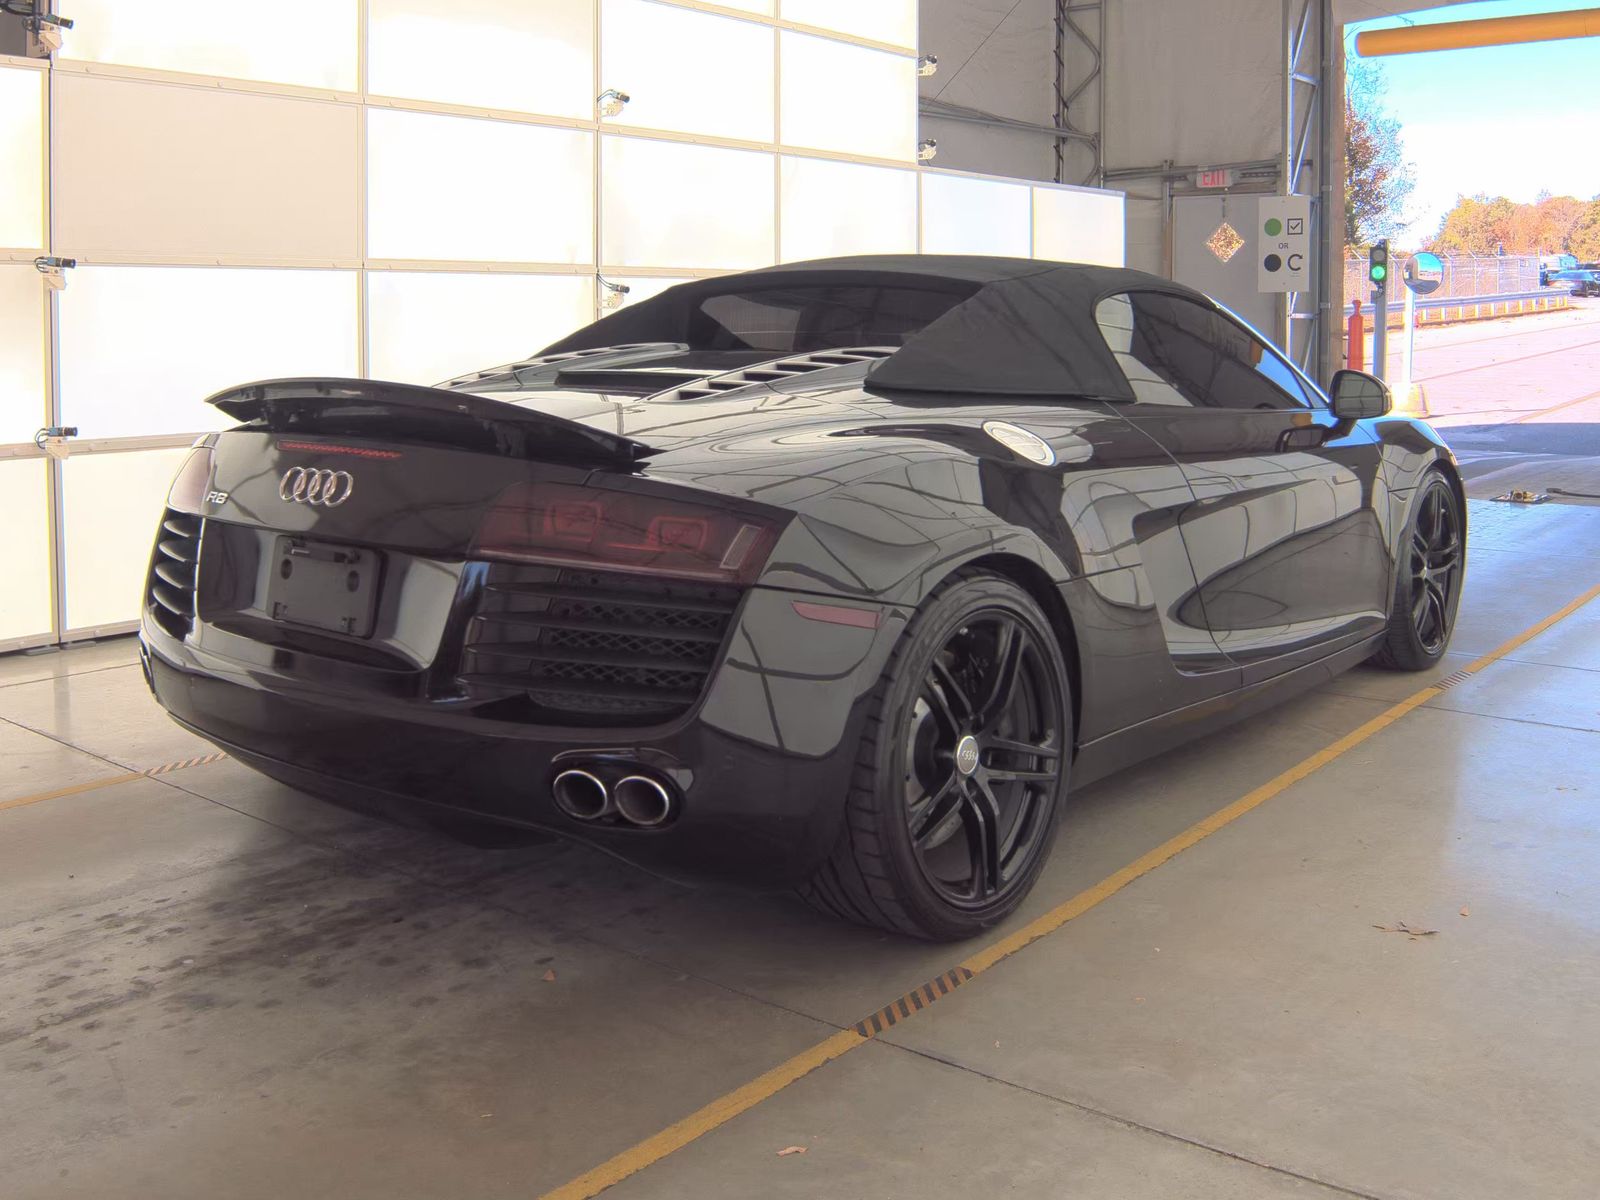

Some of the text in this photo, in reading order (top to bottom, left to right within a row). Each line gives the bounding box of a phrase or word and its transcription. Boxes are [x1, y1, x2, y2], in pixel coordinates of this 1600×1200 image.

[1202, 170, 1226, 186] EXIT
[1278, 242, 1289, 250] OR
[206, 490, 228, 504] R8
